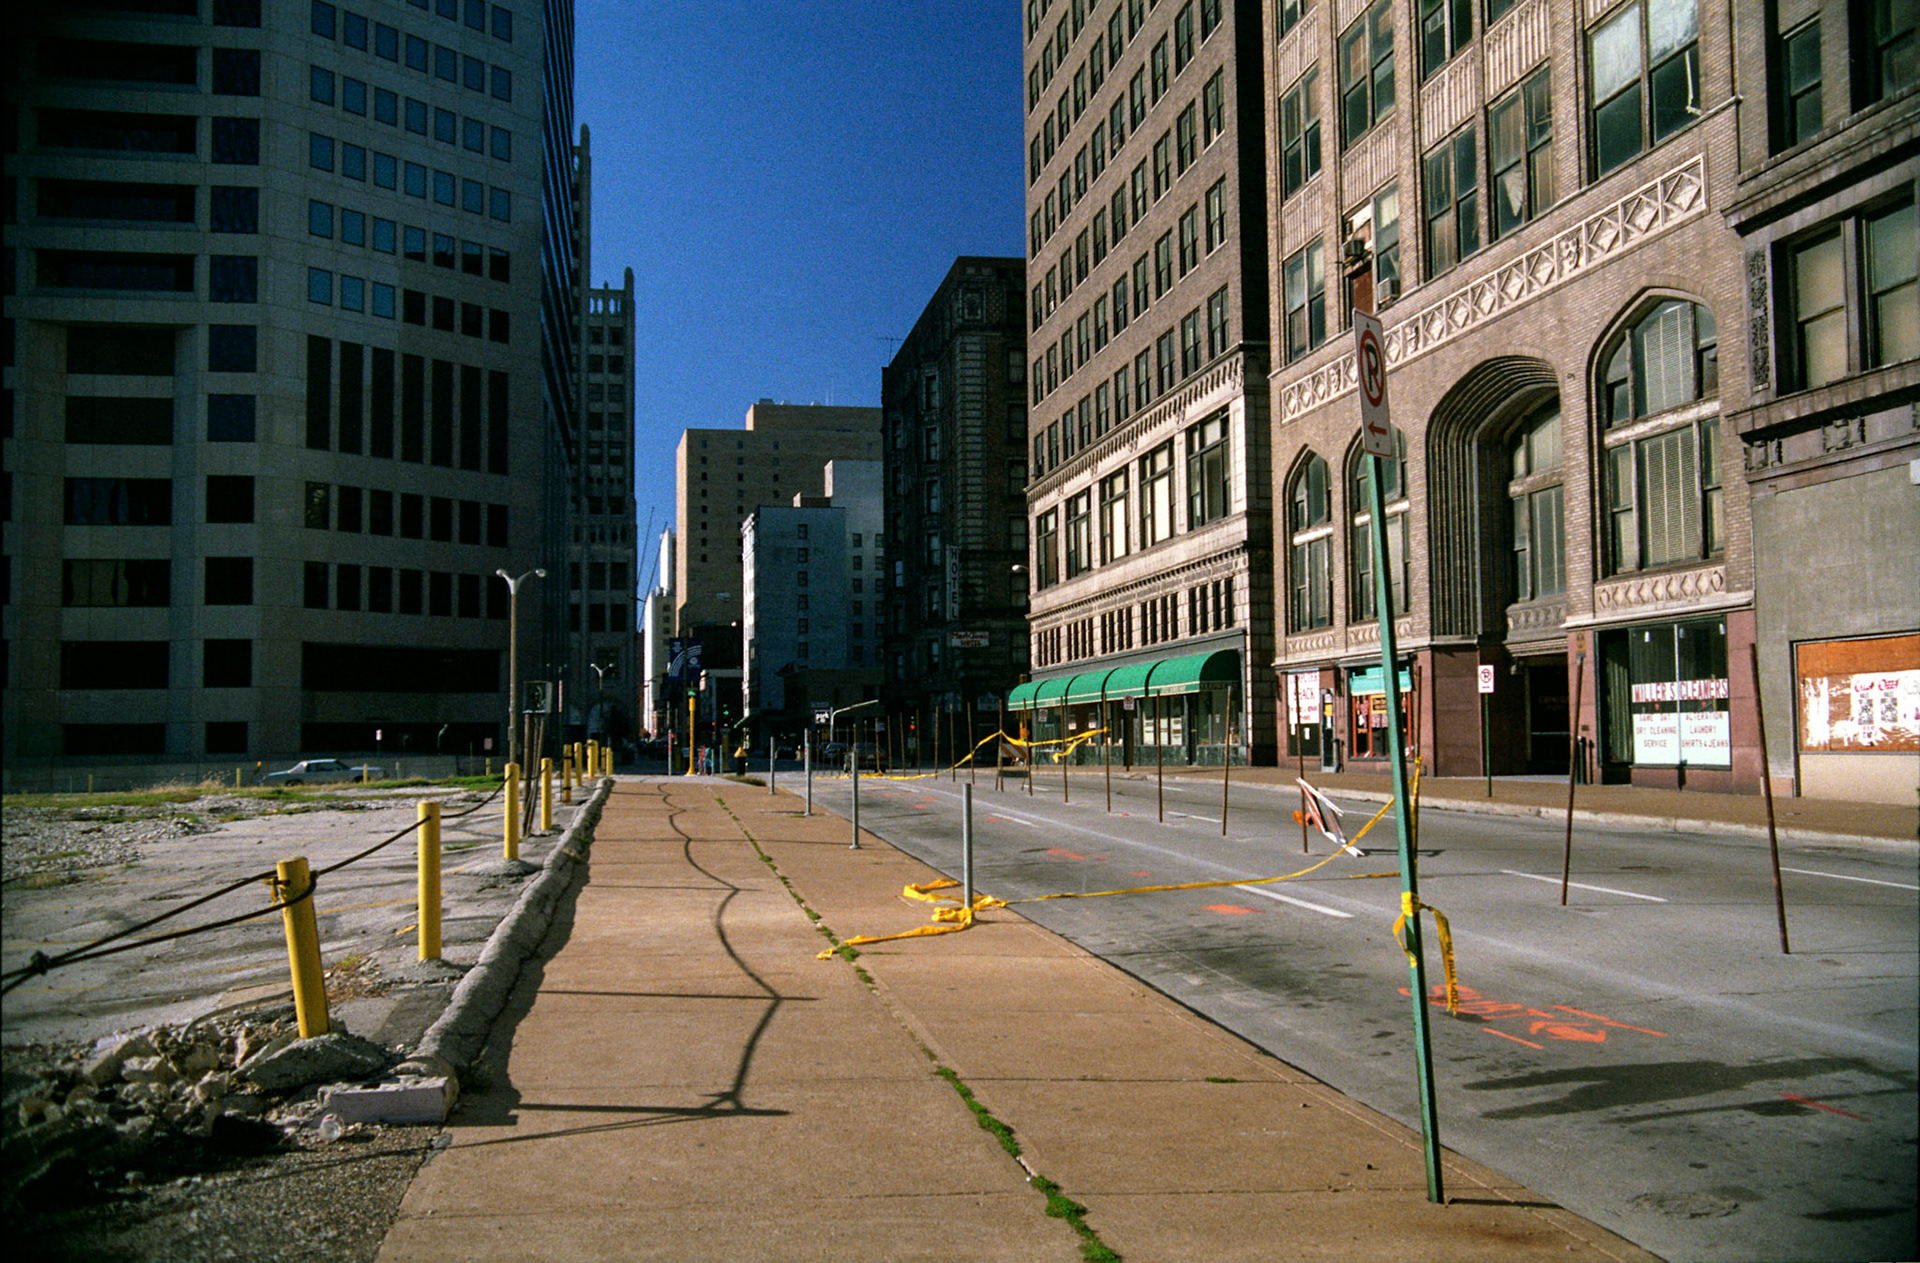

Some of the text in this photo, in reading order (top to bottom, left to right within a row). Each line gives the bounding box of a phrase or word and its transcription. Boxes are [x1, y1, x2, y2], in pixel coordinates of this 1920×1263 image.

[1680, 678, 1728, 700] CLEANERS
[1639, 713, 1654, 722] SAME
[1685, 712, 1723, 721] ALTERATION
[1636, 726, 1677, 735] DRY CLEANING
[1689, 726, 1717, 735] LAUNDRY
[1643, 739, 1668, 748] SERVICE
